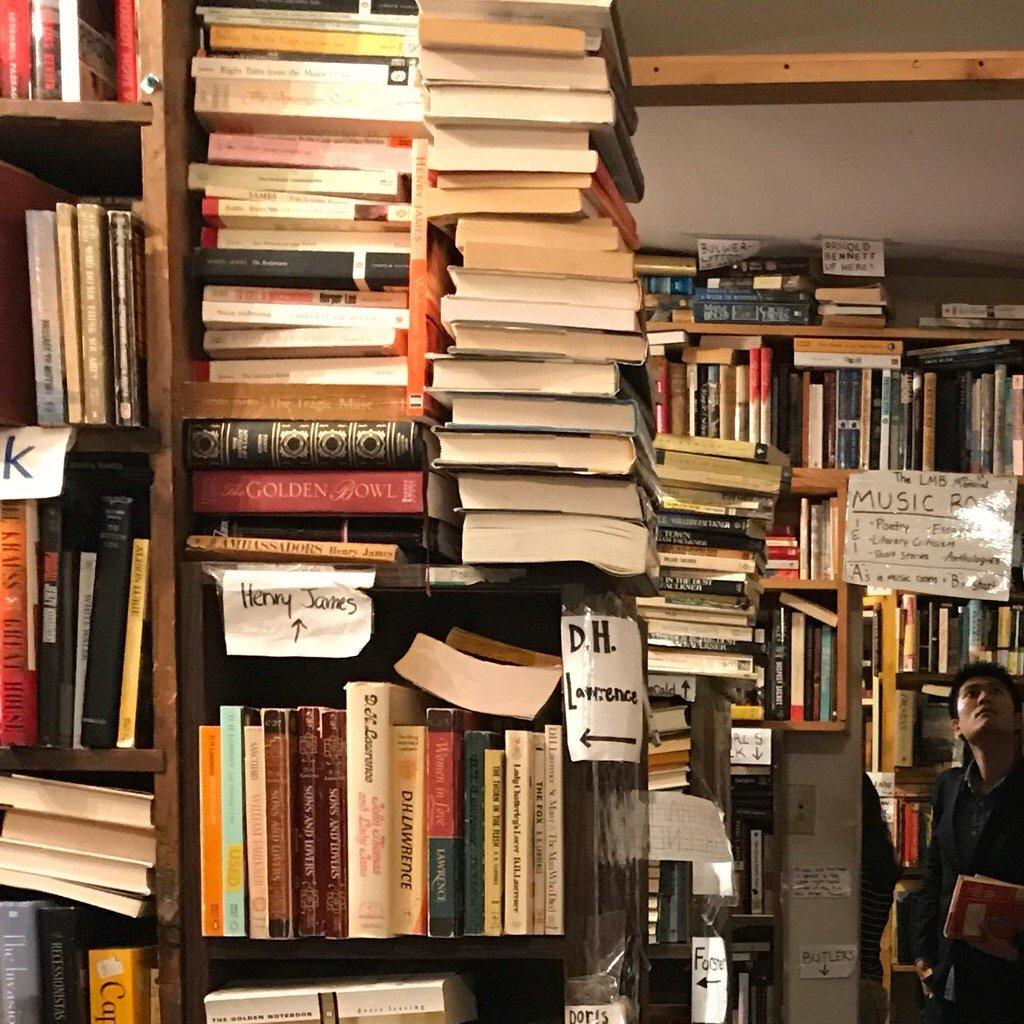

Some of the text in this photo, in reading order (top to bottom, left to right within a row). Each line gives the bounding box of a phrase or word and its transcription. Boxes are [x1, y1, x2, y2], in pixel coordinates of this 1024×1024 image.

[824, 240, 872, 251] ARNOLD
[824, 251, 877, 261] BENNETT
[246, 479, 399, 501] GOLDEN BOWL
[919, 472, 948, 488] LMB
[852, 489, 934, 512] MUSIC
[876, 517, 910, 534] Poetry
[220, 538, 395, 559] AMBASSADORS Henry James
[240, 581, 358, 619] Henry James
[568, 619, 617, 655] D.H.
[2, 618, 25, 734] GREAT HOUSE
[432, 736, 448, 784] Women
[491, 765, 502, 778] THE
[491, 780, 502, 802] THORN
[535, 781, 544, 824] THE FOX
[270, 789, 283, 839] SONS AND
[431, 801, 449, 827] Love
[491, 813, 502, 826] THE
[511, 763, 523, 854] Lady Chatterley's Lover
[302, 784, 315, 877] SONS AND LOVERS
[327, 787, 341, 880] SONS AND LOVERS
[356, 791, 371, 878] and Jane
[491, 828, 502, 848] FLESH
[225, 846, 243, 889] USED
[370, 829, 386, 876] Thomas
[434, 848, 447, 903] LAWRENCE
[3, 934, 28, 958] The
[50, 940, 65, 1022] RECESSIONISTAS
[230, 1014, 265, 1022] GOLDEN
[267, 1011, 313, 1020] NOTEBOOK
[356, 1006, 384, 1014] doris
[388, 1003, 426, 1013] lessing
